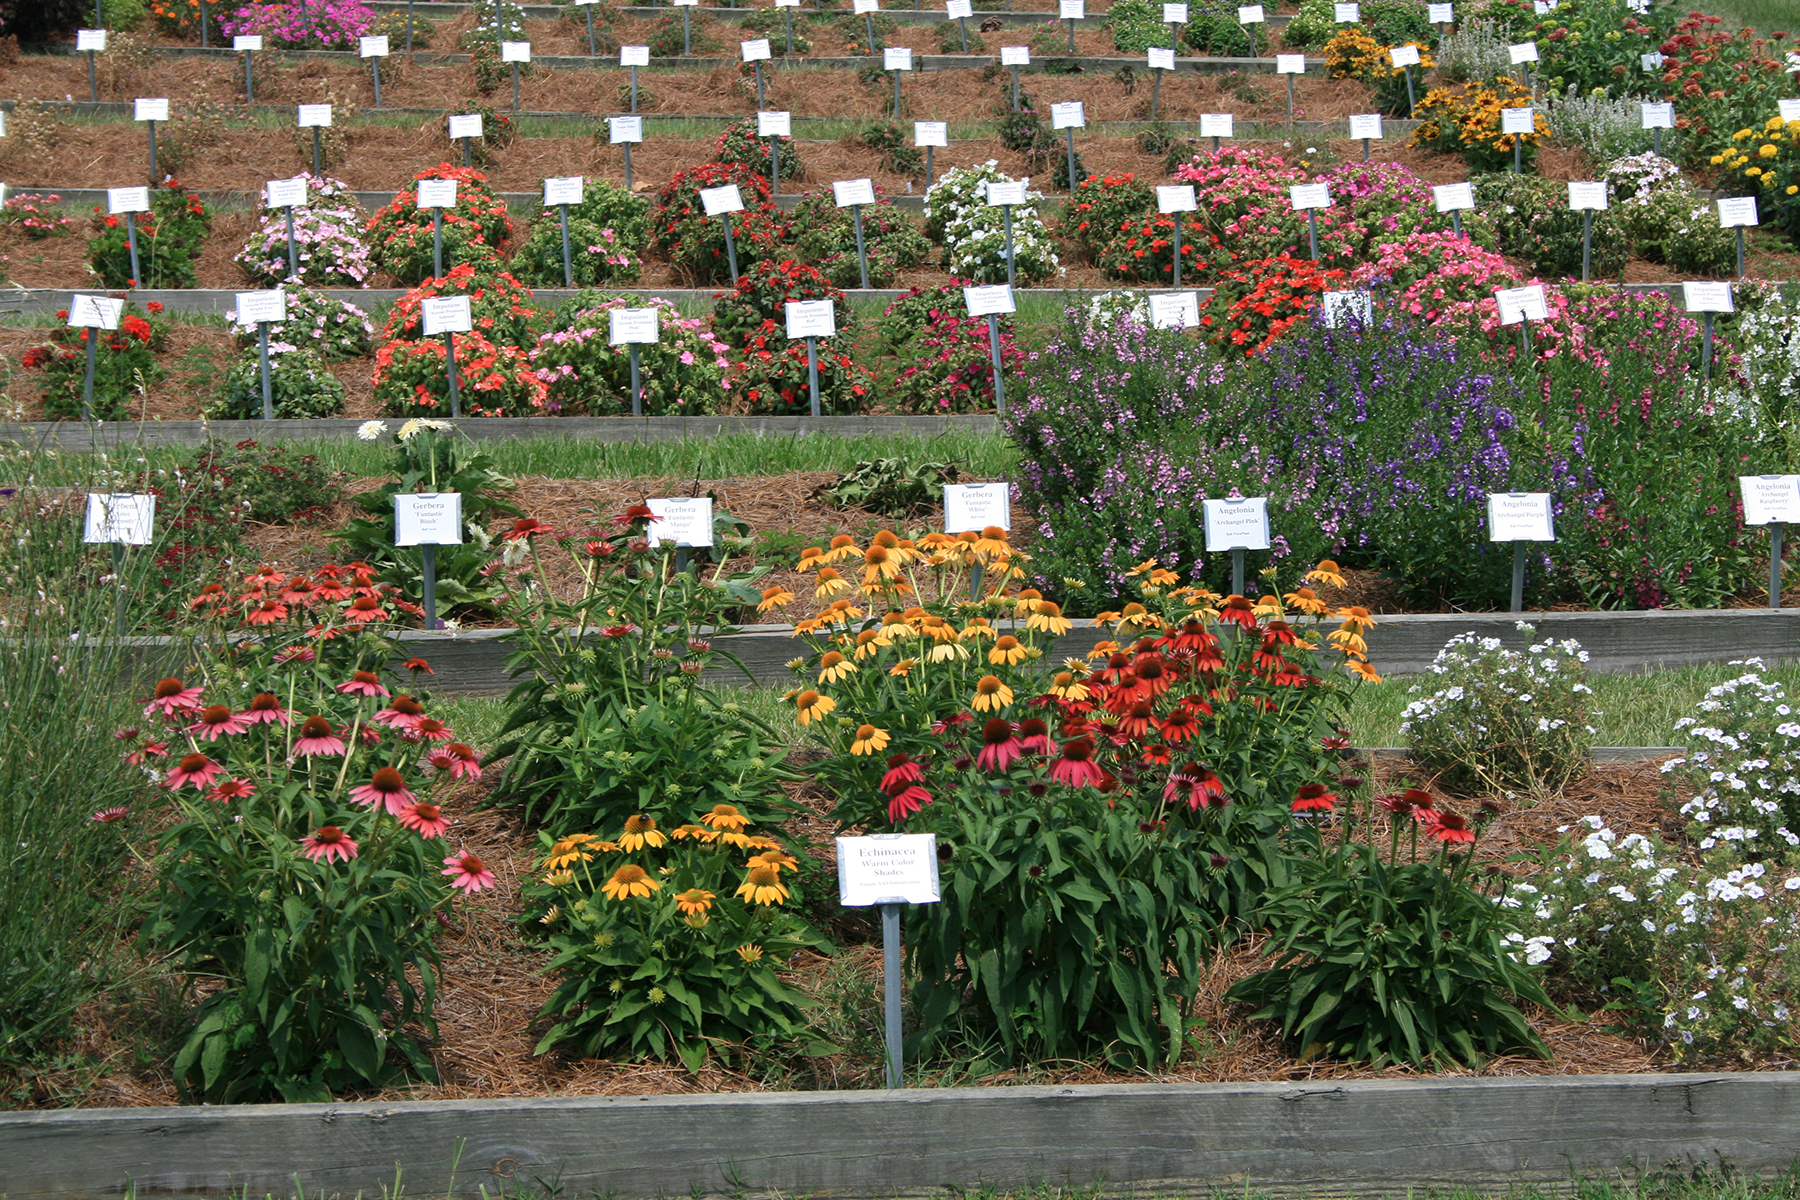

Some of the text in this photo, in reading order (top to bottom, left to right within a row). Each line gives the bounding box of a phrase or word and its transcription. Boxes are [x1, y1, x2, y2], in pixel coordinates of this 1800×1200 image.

[1755, 483, 1791, 492] Angelonia
[1501, 500, 1538, 510] Angelonia
[1218, 506, 1255, 515] Angelonia
[859, 848, 916, 858] Echinacea
[874, 869, 904, 877] Shades
